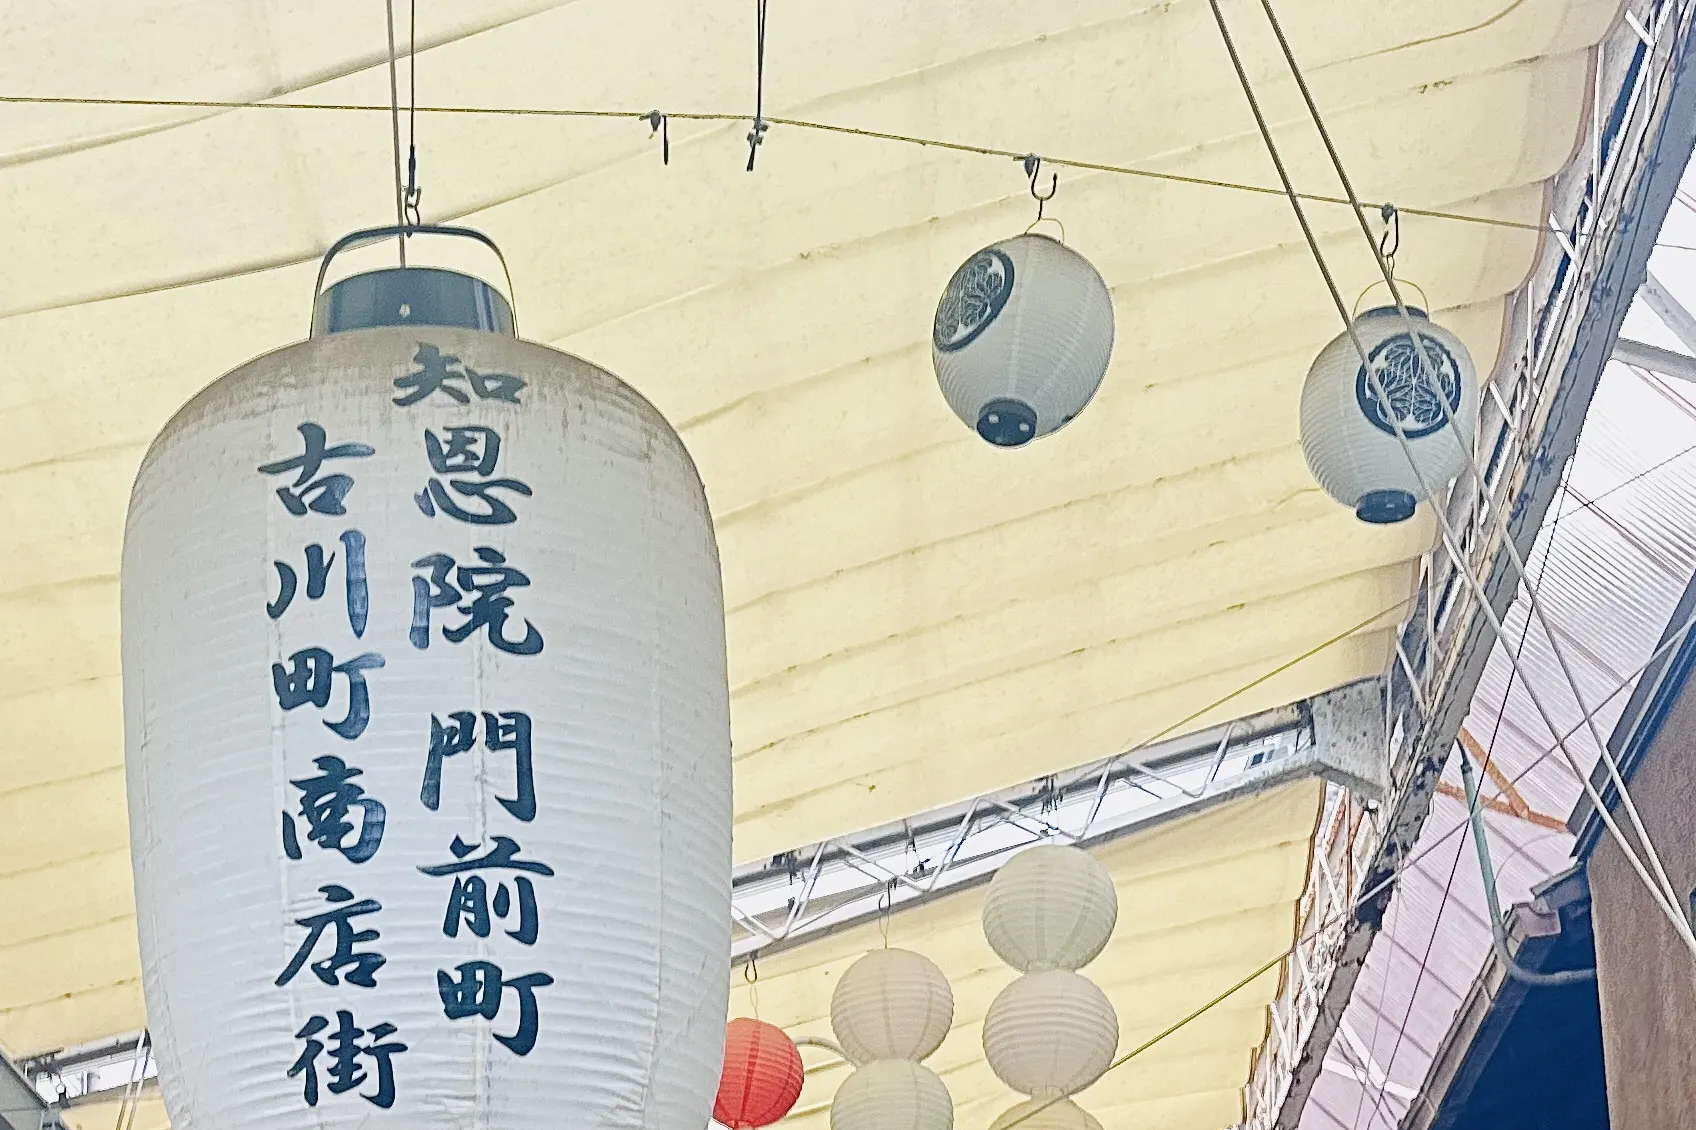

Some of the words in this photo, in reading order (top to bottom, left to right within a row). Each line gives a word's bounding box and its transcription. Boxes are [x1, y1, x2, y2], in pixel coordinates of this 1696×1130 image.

[257, 421, 408, 1108] 古川町商店街
